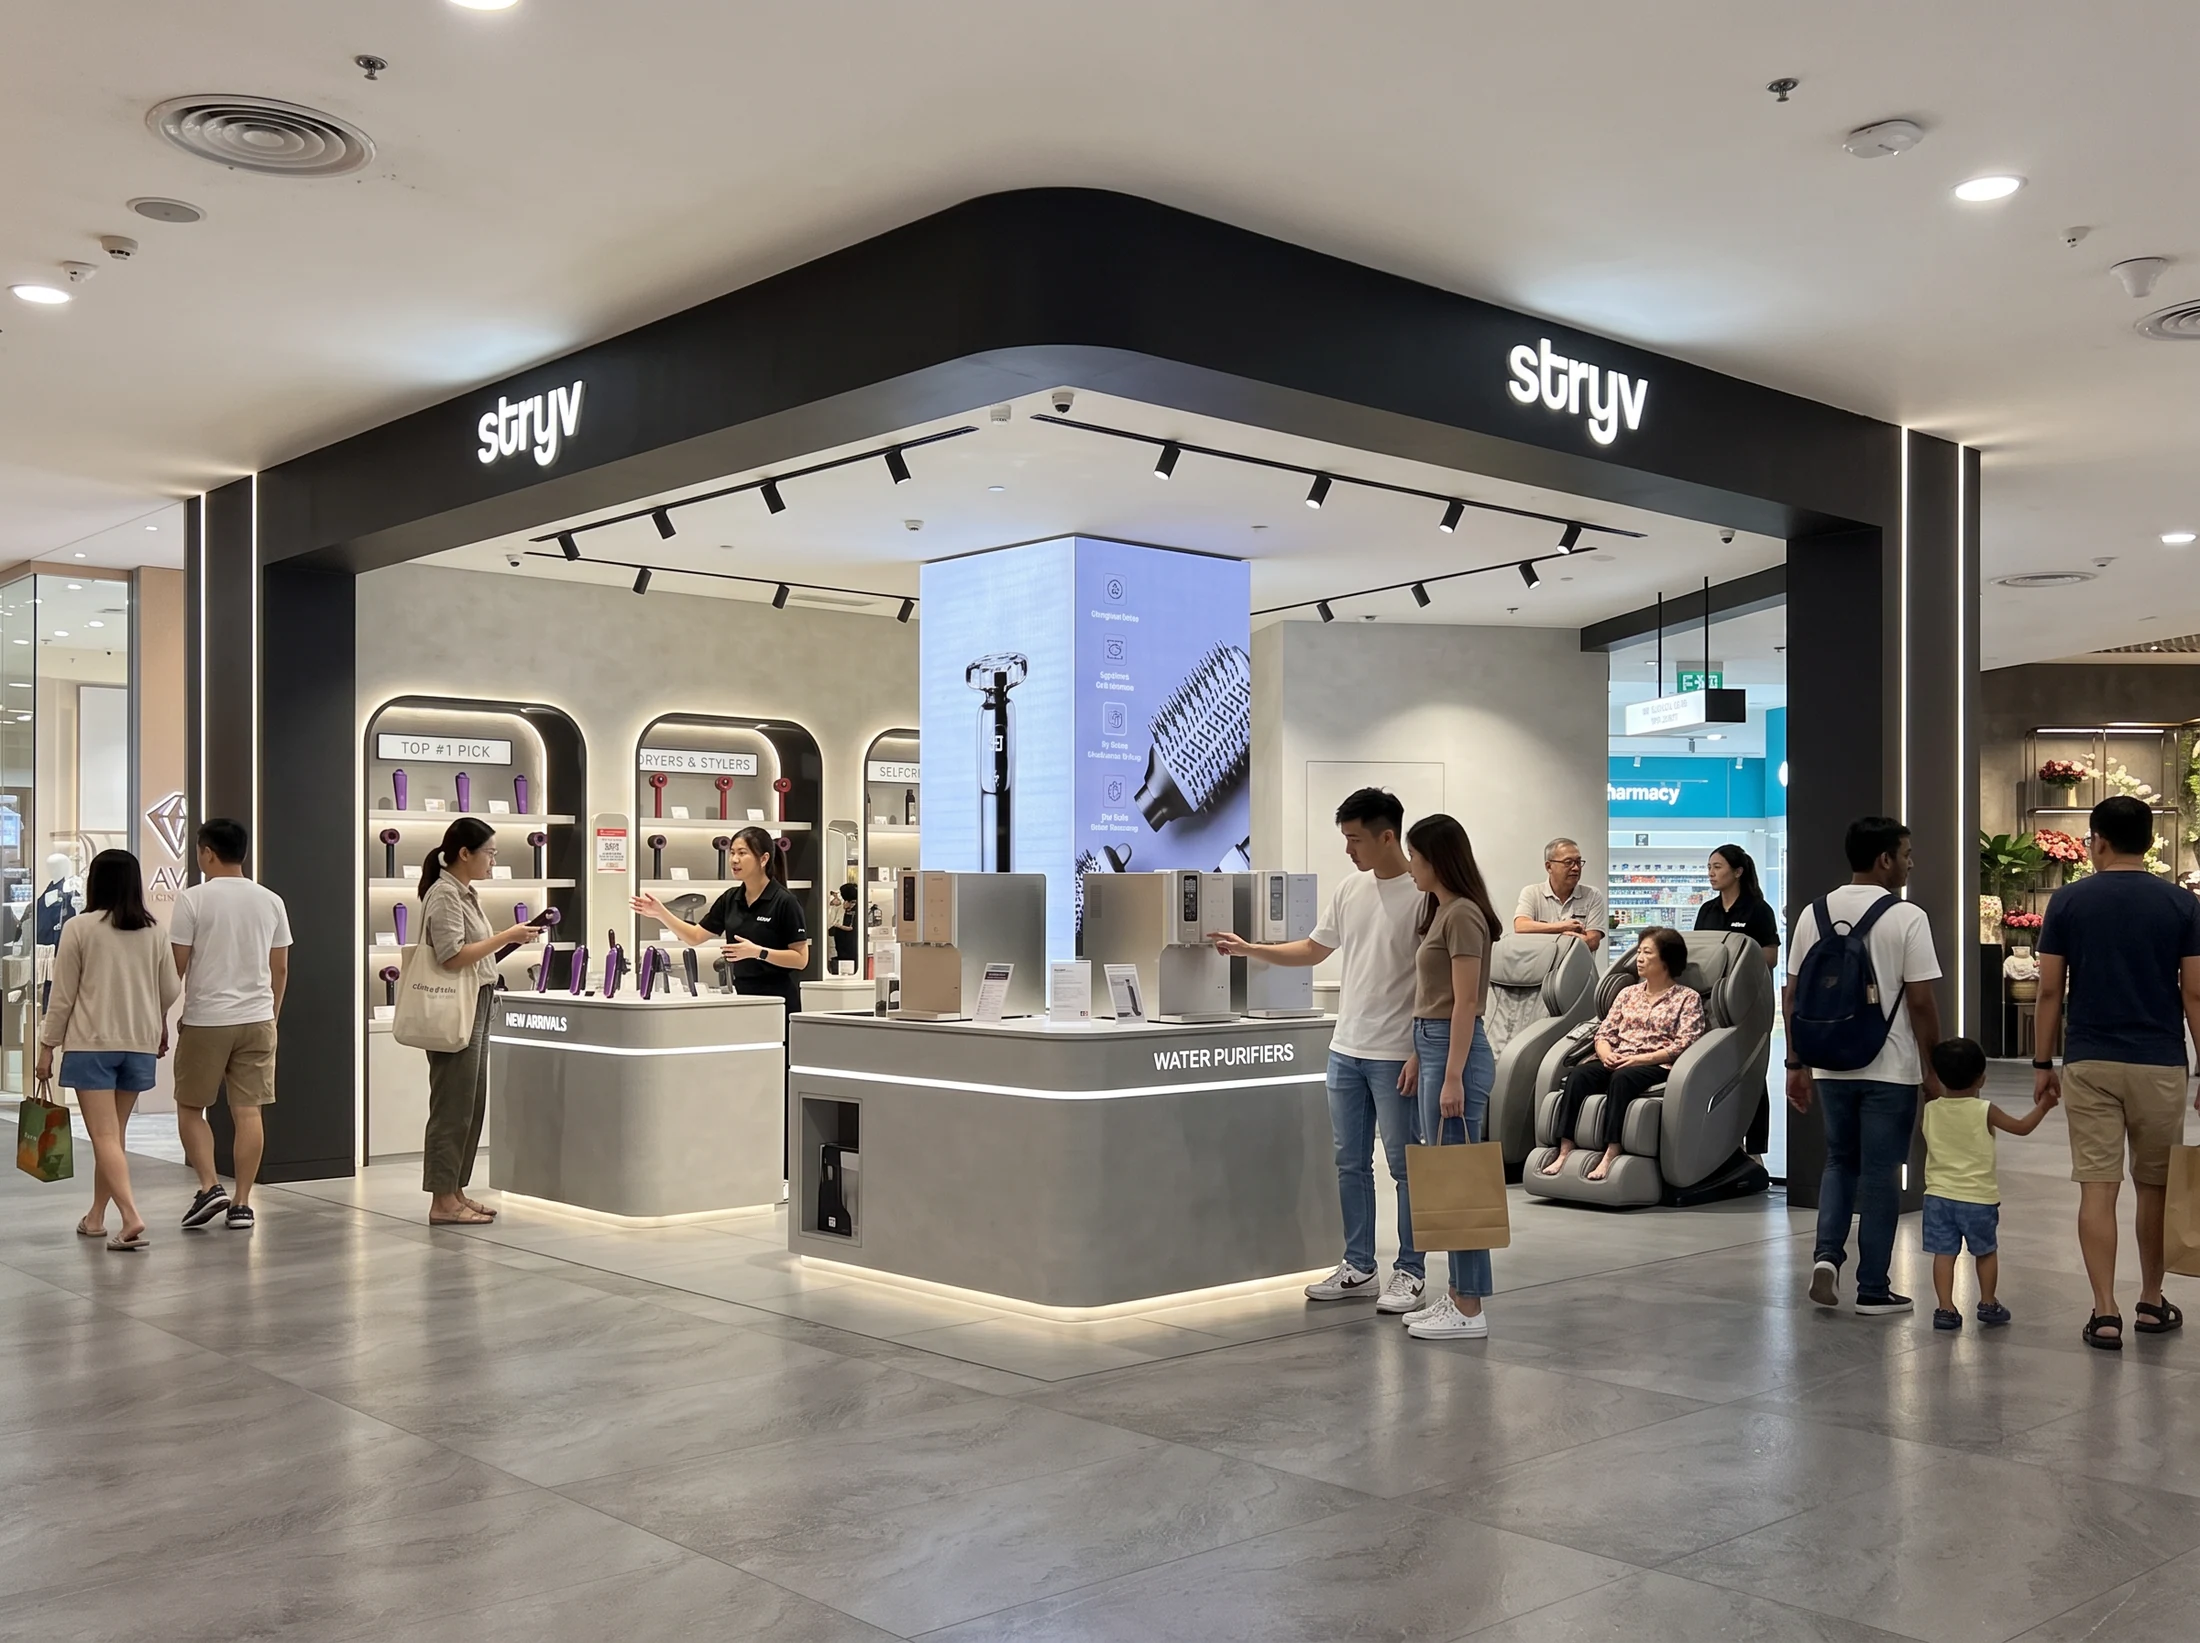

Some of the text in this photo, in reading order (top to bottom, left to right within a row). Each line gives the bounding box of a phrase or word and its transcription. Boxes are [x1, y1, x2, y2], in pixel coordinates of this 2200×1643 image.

[1508, 337, 1649, 445] stryv
[477, 380, 583, 466] stryv
[401, 741, 490, 758] TOP #1 PICK
[687, 756, 697, 768] &
[701, 757, 750, 771] STYLERS
[505, 1012, 568, 1032] NEW ARRIVALS
[1153, 1043, 1295, 1071] WATER PURIFIERS
